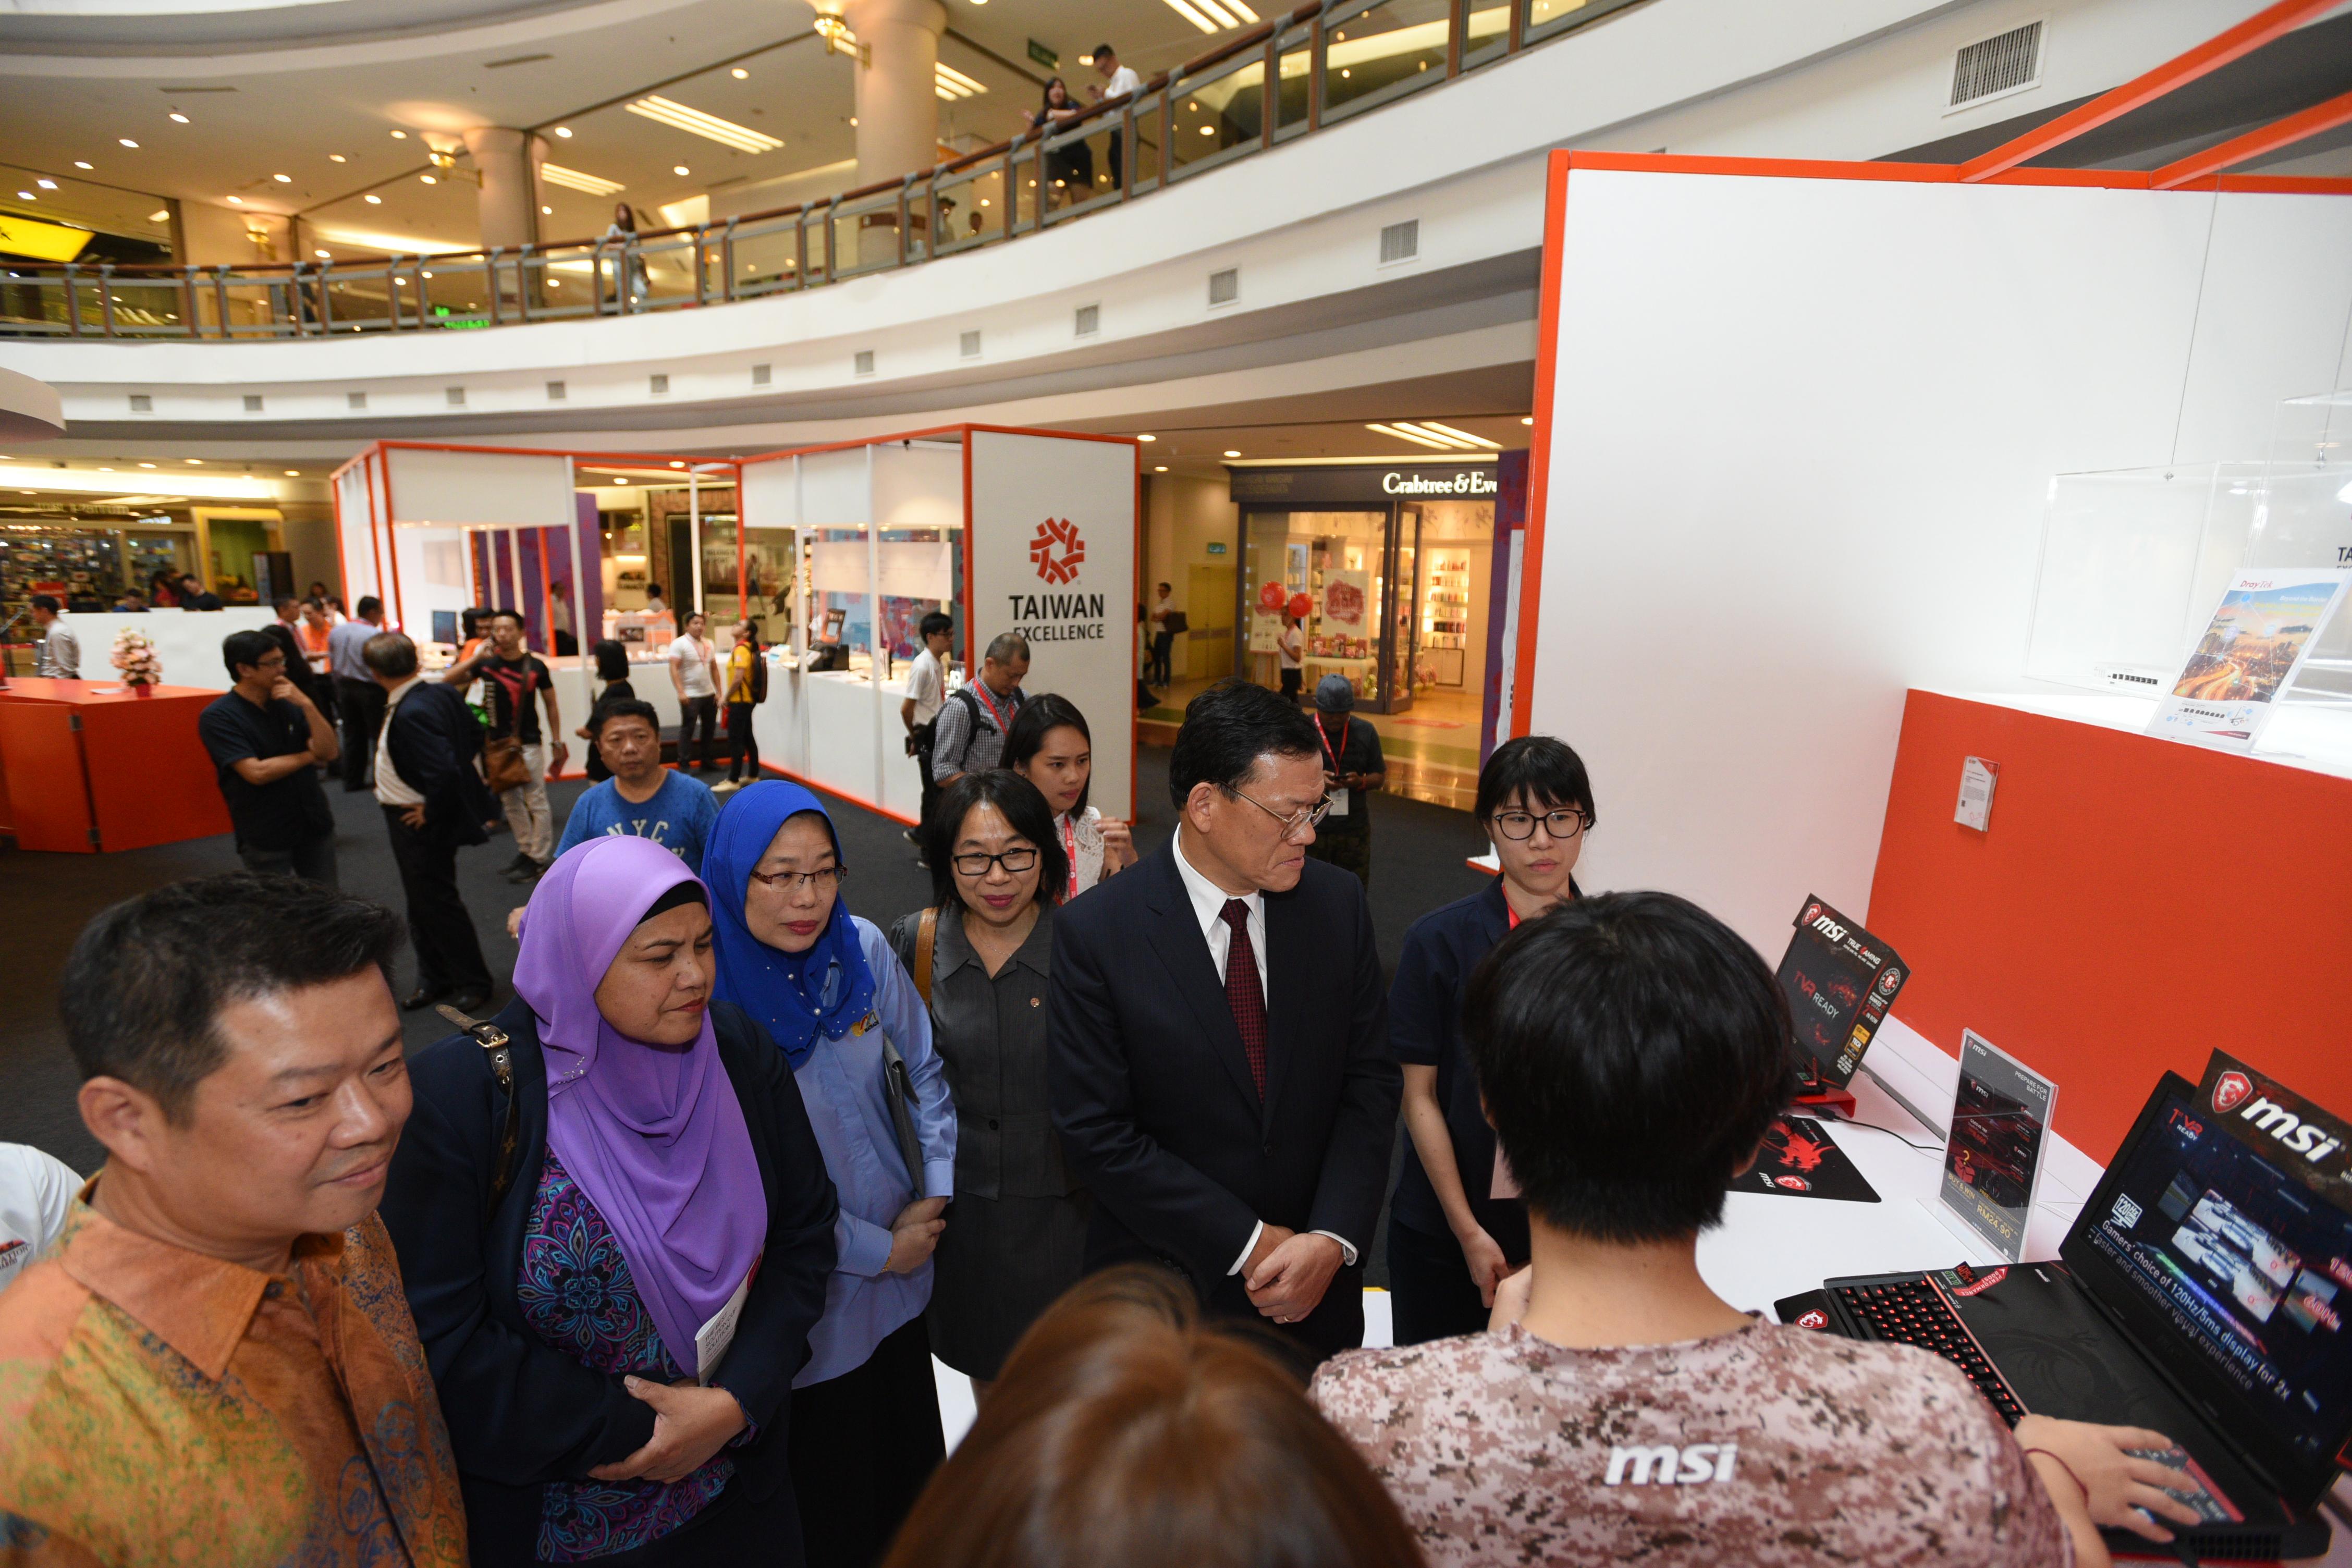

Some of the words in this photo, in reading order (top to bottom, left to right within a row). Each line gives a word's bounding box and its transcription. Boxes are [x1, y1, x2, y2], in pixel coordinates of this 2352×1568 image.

[1382, 472, 1453, 494] Crabtree
[1453, 473, 1469, 494] &
[2240, 580, 2273, 590] DrayTek
[1008, 594, 1104, 620] TAIWAN
[1812, 914, 1848, 942] msi
[1846, 937, 1861, 951] TRUE
[1813, 992, 1840, 1020] READY
[1973, 1044, 1987, 1057] msi
[1976, 1084, 1989, 1098] msi
[2015, 1071, 2037, 1088] PREPARE
[2036, 1084, 2048, 1095] FOR
[2026, 1085, 2047, 1101] BATTLE
[2176, 1124, 2198, 1141] READY
[2240, 1097, 2341, 1163] msi
[1948, 1173, 1959, 1185] BUY
[1964, 1186, 1975, 1199] WIN
[1977, 1204, 2011, 1239] RM24.90
[1961, 1275, 2002, 1296] PERFORMANCE
[1981, 1271, 1999, 1283] BOOST
[2094, 1232, 2117, 1258] faster
[2116, 1255, 2133, 1273] and
[2131, 1270, 2172, 1310] smoother
[2172, 1307, 2199, 1338] visual
[2199, 1335, 2252, 1390] experience
[2134, 1251, 2160, 1279] choice
[2160, 1276, 2173, 1288] of
[2171, 1283, 2221, 1336] 120Hz/5ms
[2220, 1332, 2259, 1371] display
[2257, 1363, 2275, 1385] for
[2274, 1379, 2291, 1402] 2x
[1604, 1443, 1738, 1485] msi
